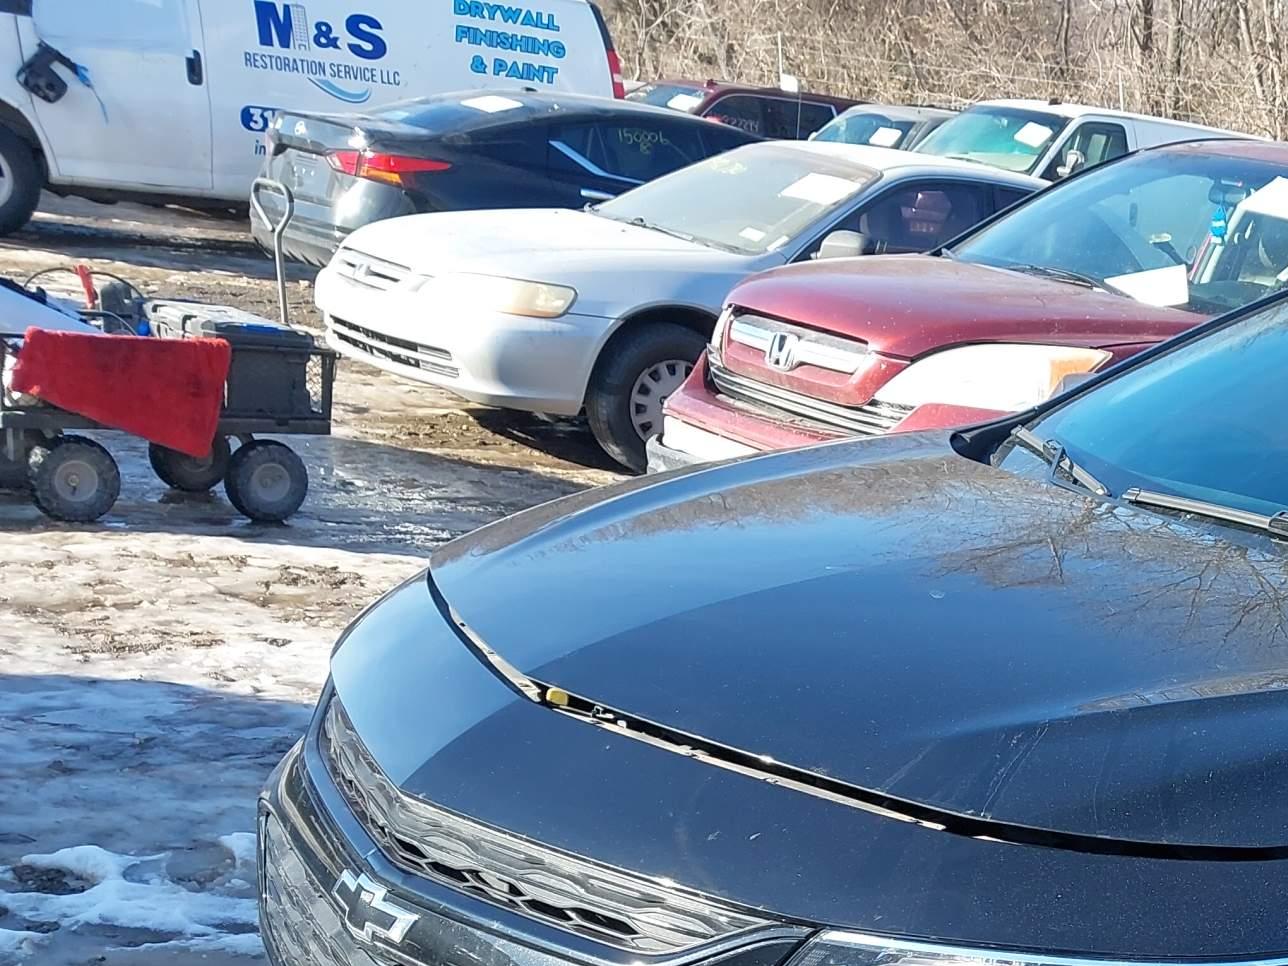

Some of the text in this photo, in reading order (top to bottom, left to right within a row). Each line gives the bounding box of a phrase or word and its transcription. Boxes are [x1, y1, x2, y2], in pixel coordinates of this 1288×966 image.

[454, 0, 560, 32] DRYWALL
[313, 21, 342, 50] &
[345, 14, 388, 60] S
[455, 25, 566, 59] FINISHING
[244, 51, 401, 86] RESTORATION SERVICE LLC
[470, 55, 559, 84] & PAINT
